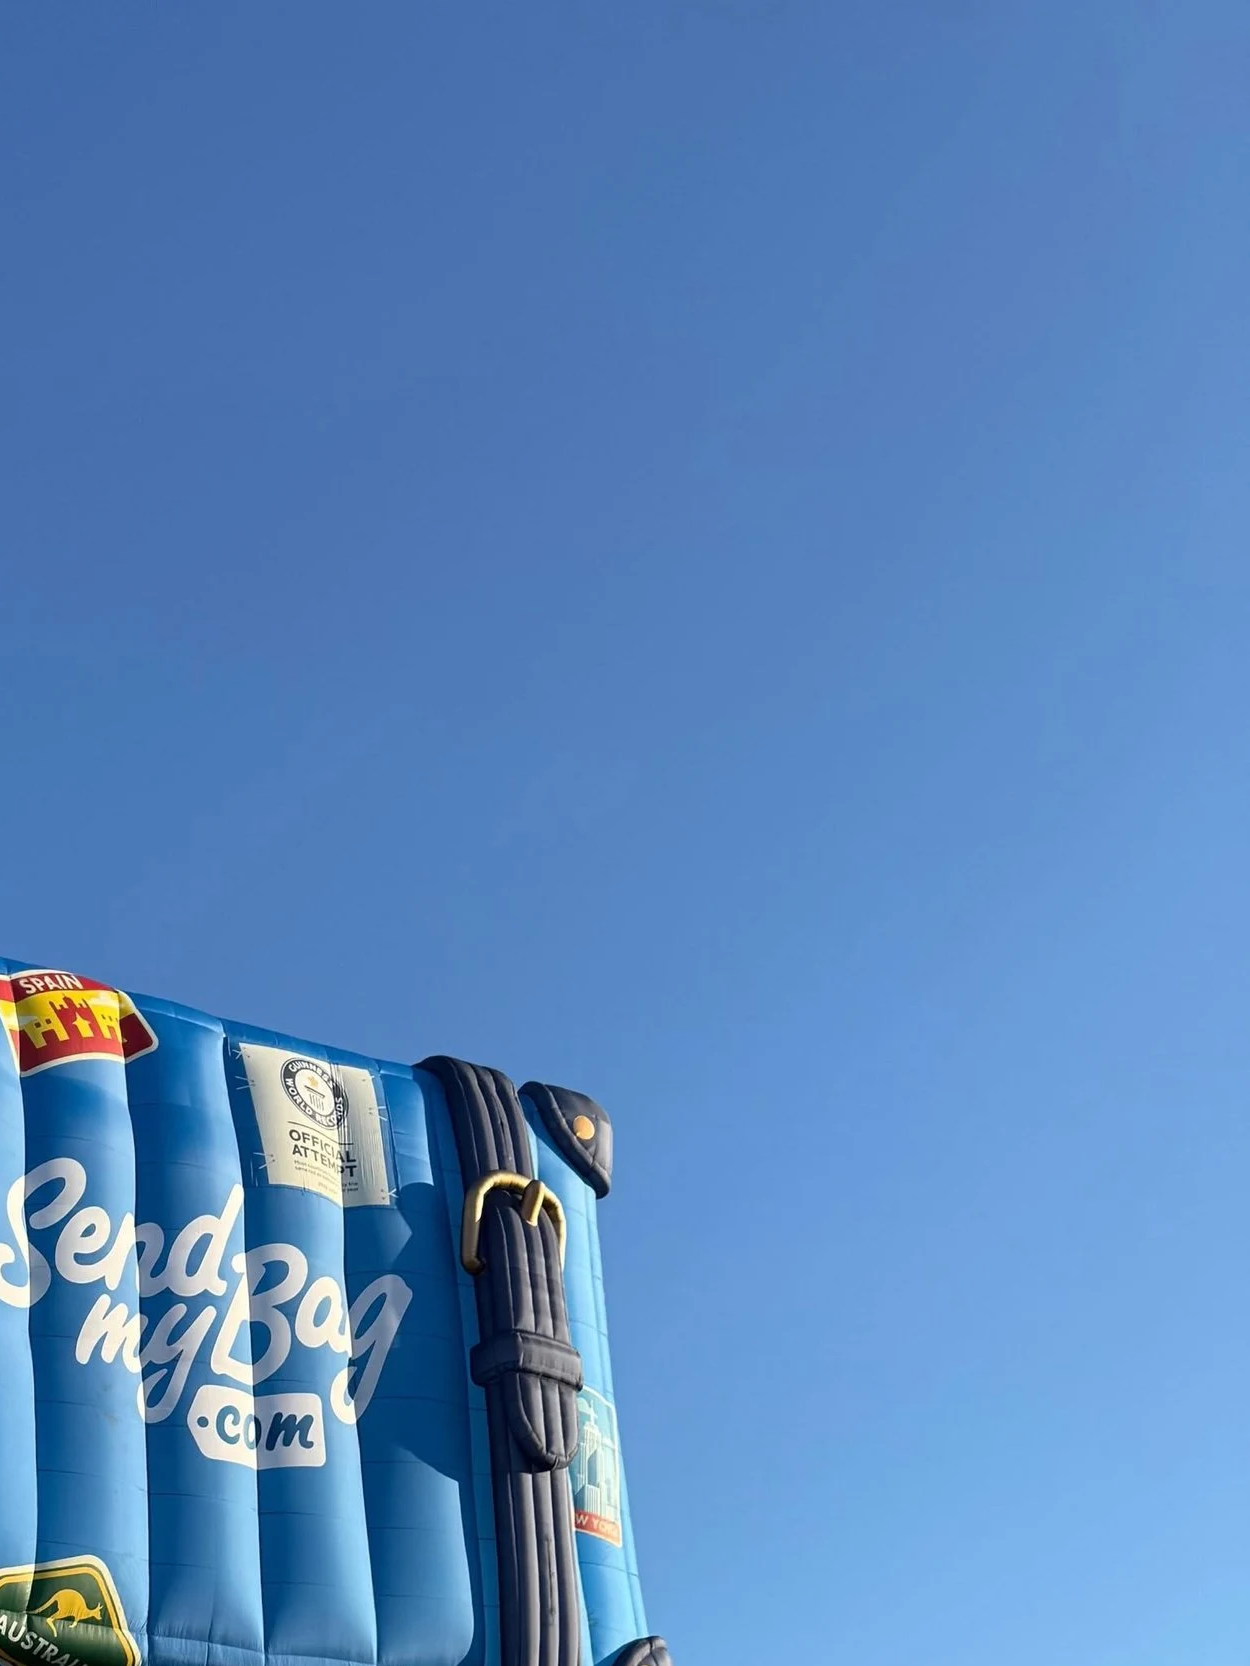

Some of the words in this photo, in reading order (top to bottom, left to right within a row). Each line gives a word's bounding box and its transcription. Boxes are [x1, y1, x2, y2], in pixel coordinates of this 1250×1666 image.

[19, 974, 84, 995] SPAIN
[285, 1078, 313, 1115] WORLD
[289, 1129, 357, 1163] OFFICIAL
[292, 1144, 357, 1178] ATTEMPT
[75, 1294, 217, 1424] my
[210, 1243, 414, 1425] Bag
[197, 1404, 315, 1452] .com
